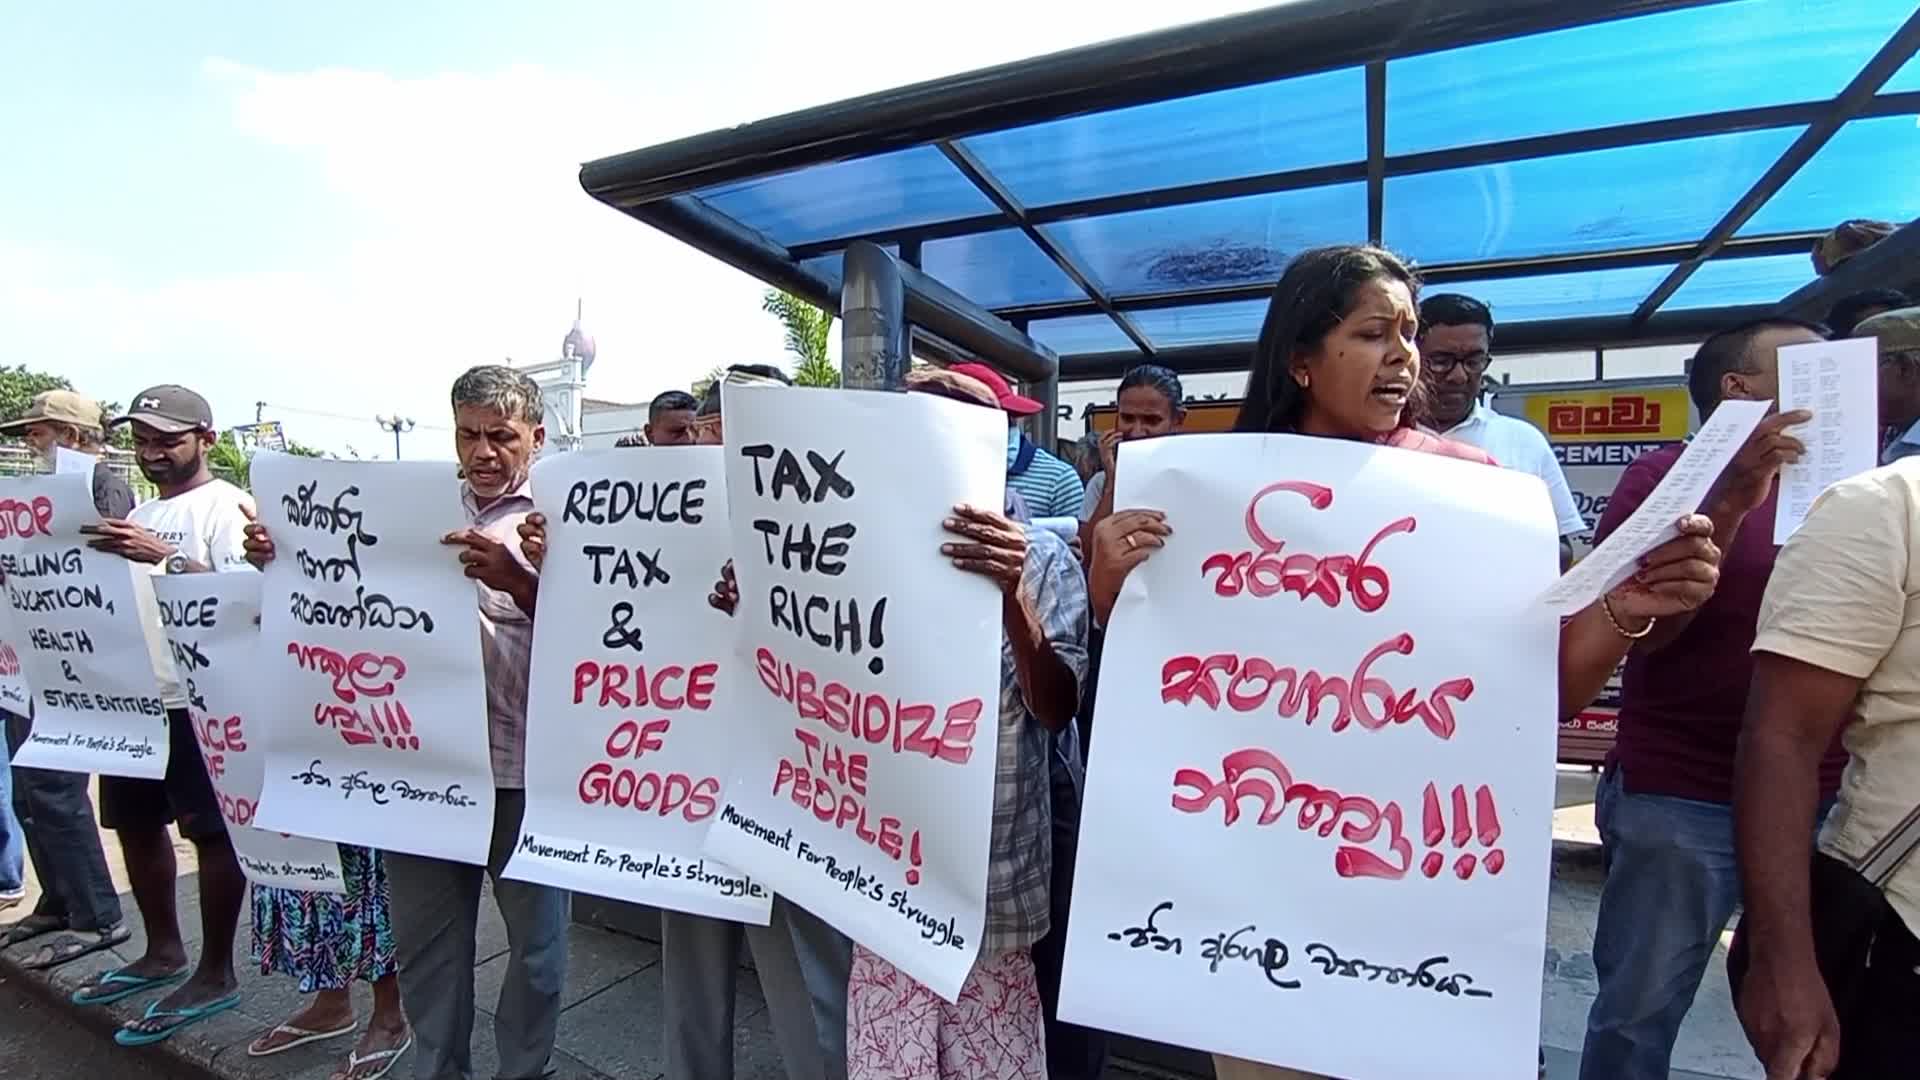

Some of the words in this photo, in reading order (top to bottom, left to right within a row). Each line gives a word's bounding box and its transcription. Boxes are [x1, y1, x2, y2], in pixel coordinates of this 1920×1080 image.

[741, 444, 855, 503] TAX
[562, 478, 707, 524] REDUCE
[583, 544, 671, 588] TAX
[754, 520, 857, 576] THE
[28, 628, 94, 653] HEALTH
[602, 601, 643, 652] &
[769, 585, 887, 675] RICH!
[61, 660, 82, 683] &
[187, 678, 208, 712] &
[573, 660, 718, 710] PRICE
[43, 689, 94, 711] STATE
[756, 647, 983, 765] SUBSIDIZE
[605, 719, 671, 760] OF
[795, 728, 868, 796] THE
[578, 762, 721, 824] GOODS
[773, 758, 923, 886] PEOPLE!
[518, 832, 590, 864] Movement
[594, 848, 617, 868] For
[619, 853, 682, 880] People's
[720, 804, 792, 851] Movement
[825, 855, 884, 902] People's
